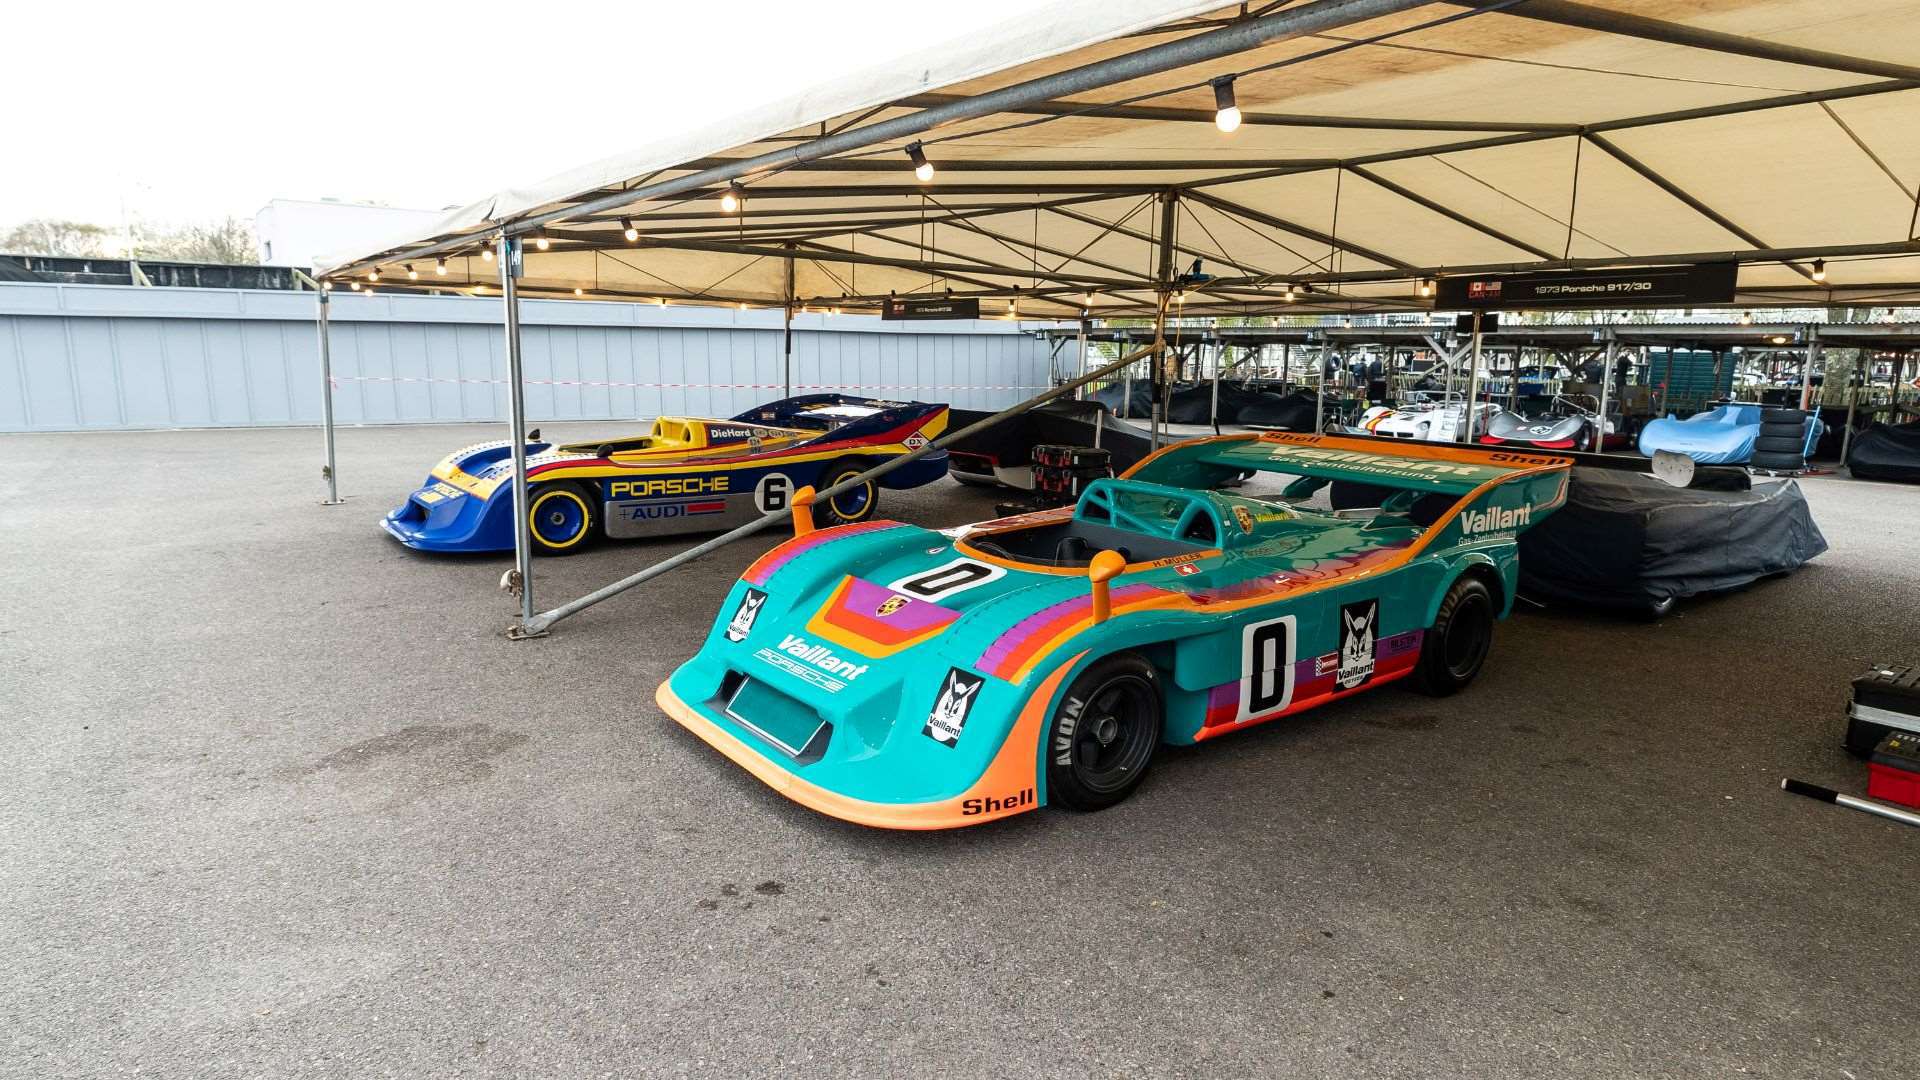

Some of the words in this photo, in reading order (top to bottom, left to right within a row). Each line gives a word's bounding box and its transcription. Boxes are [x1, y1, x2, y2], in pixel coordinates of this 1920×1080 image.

[1535, 286, 1560, 294] 1973
[1561, 284, 1606, 293] Porsche
[1607, 282, 1652, 291] 917/30
[711, 429, 751, 438] DieHard
[1266, 432, 1322, 443] Shell
[1271, 446, 1481, 476] Vaillant
[1489, 452, 1566, 466] Shell
[611, 476, 729, 497] PORSCHE
[763, 477, 788, 511] 6
[1461, 502, 1531, 535] Vaillant
[902, 562, 992, 596] 0
[756, 648, 847, 692] PORSCHE
[777, 634, 870, 681] Vaillant
[1249, 621, 1287, 713] 0
[1338, 660, 1374, 680] Vaillant
[929, 714, 961, 737] Vaillant
[1055, 696, 1084, 766] AVON
[962, 788, 1033, 815] Shell
